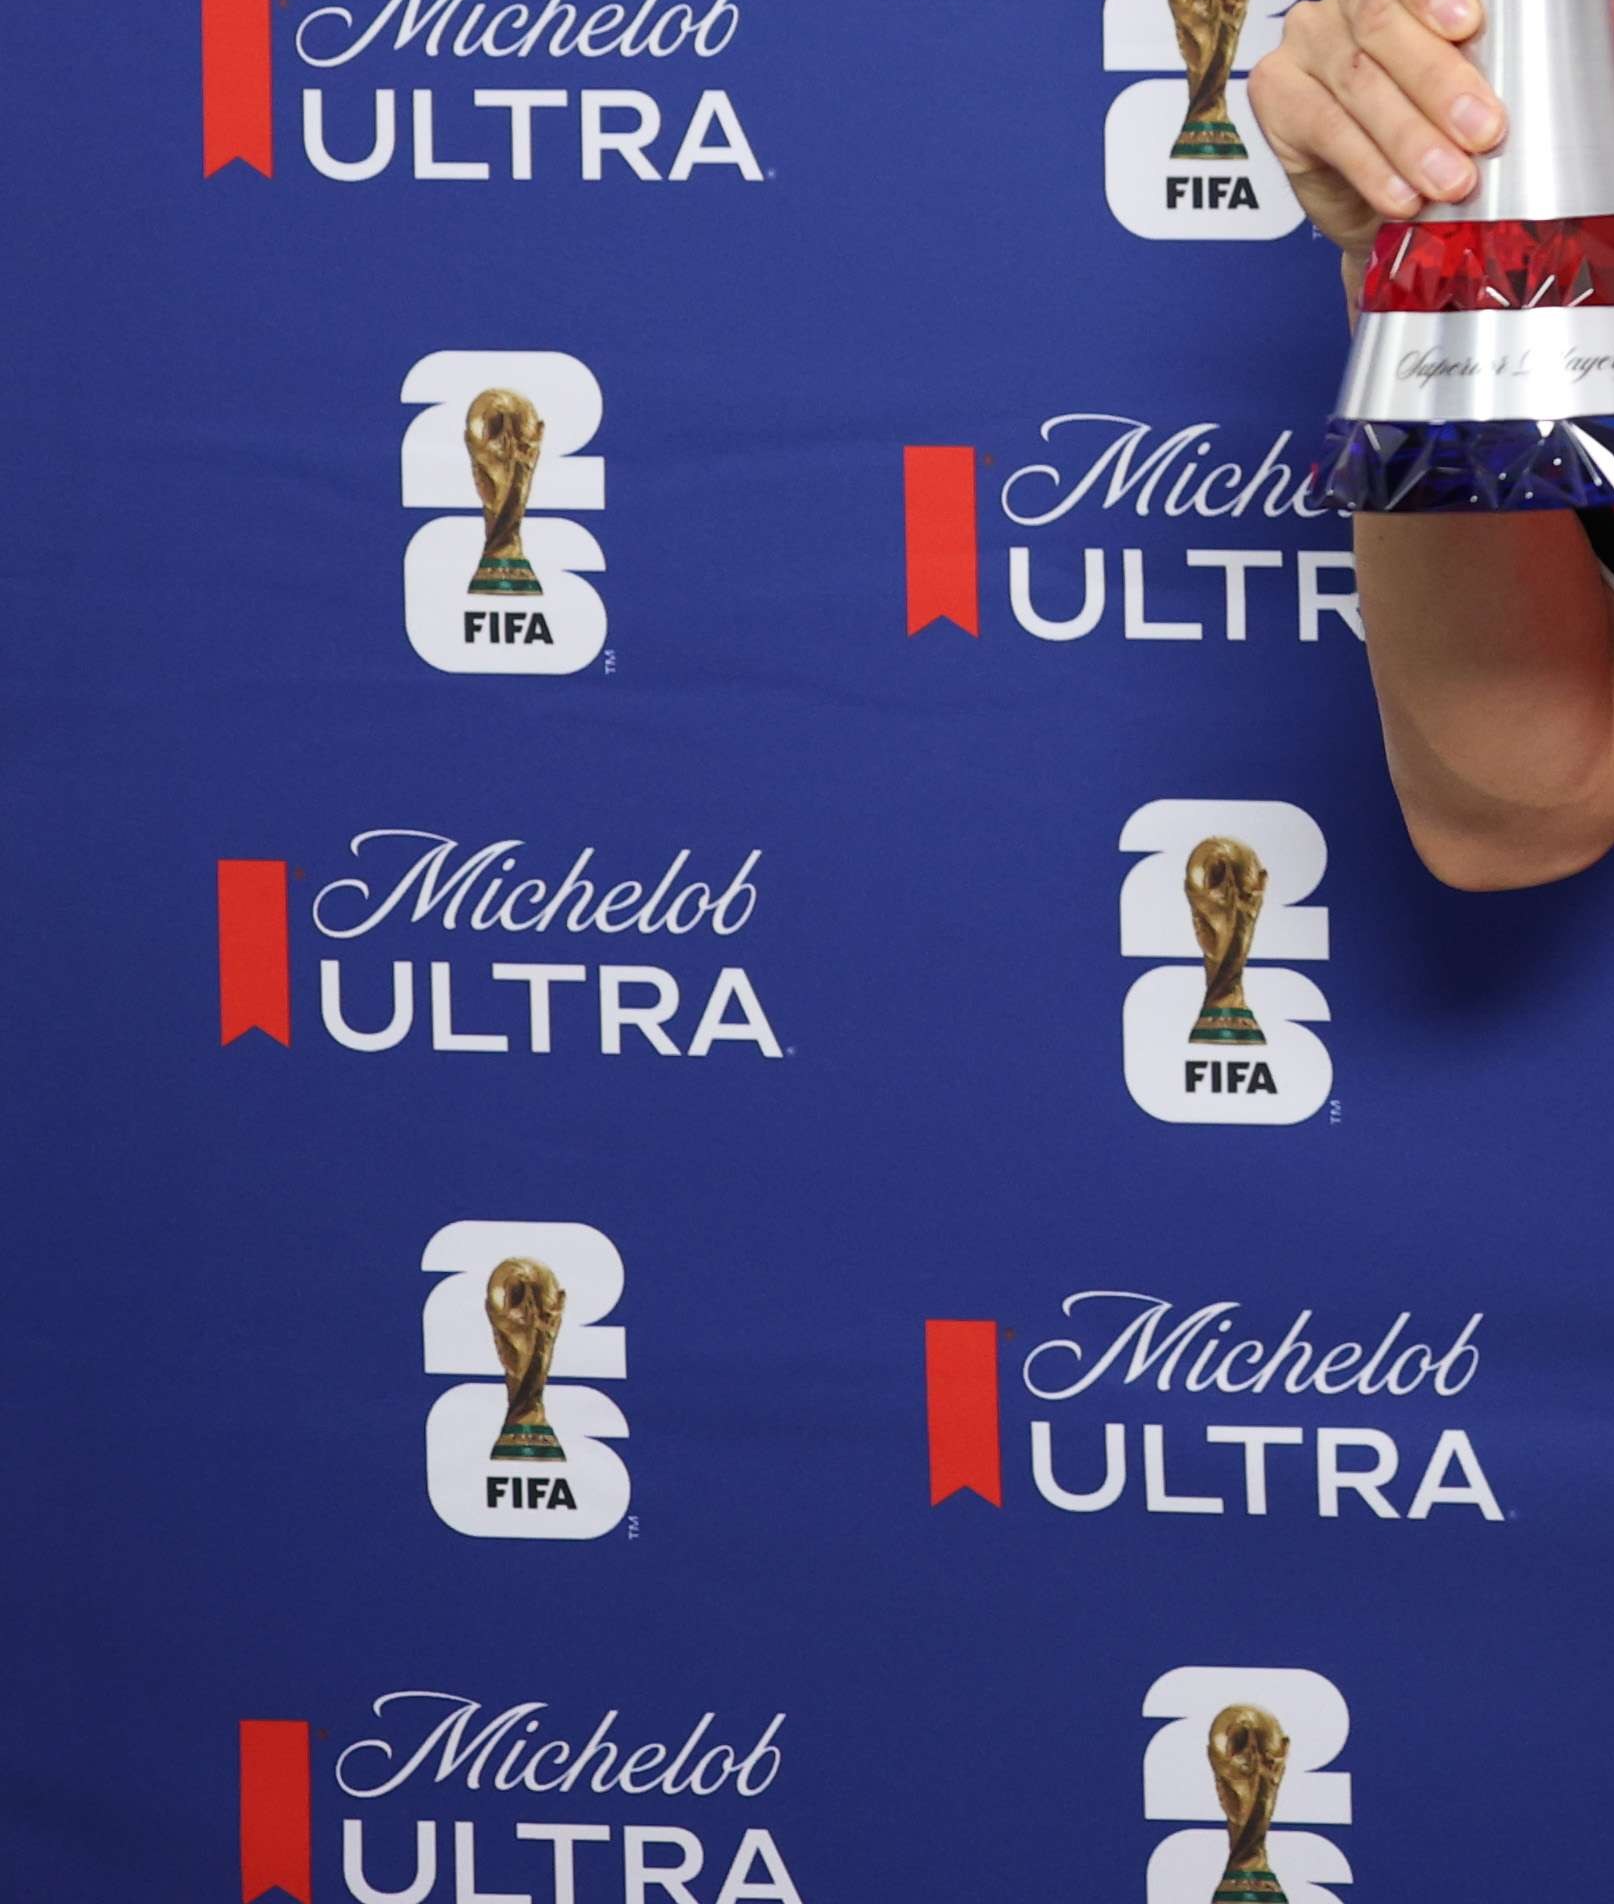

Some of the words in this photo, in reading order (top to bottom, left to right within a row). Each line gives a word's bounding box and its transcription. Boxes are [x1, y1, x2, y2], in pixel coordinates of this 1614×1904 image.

[302, 88, 764, 182] ULTRA
[1166, 176, 1260, 210] FIFA
[1001, 413, 1353, 526] Mich
[464, 611, 554, 645] FIFA
[312, 829, 762, 939] Michelob
[320, 959, 784, 1058] ULTRA
[1185, 1060, 1278, 1095] FIFA
[1023, 1290, 1484, 1400] Michelob
[486, 1476, 577, 1510] FIFA
[1031, 1421, 1505, 1521] ULTRA
[335, 1691, 786, 1798] Michelob
[343, 1819, 806, 1904] ULTRA
